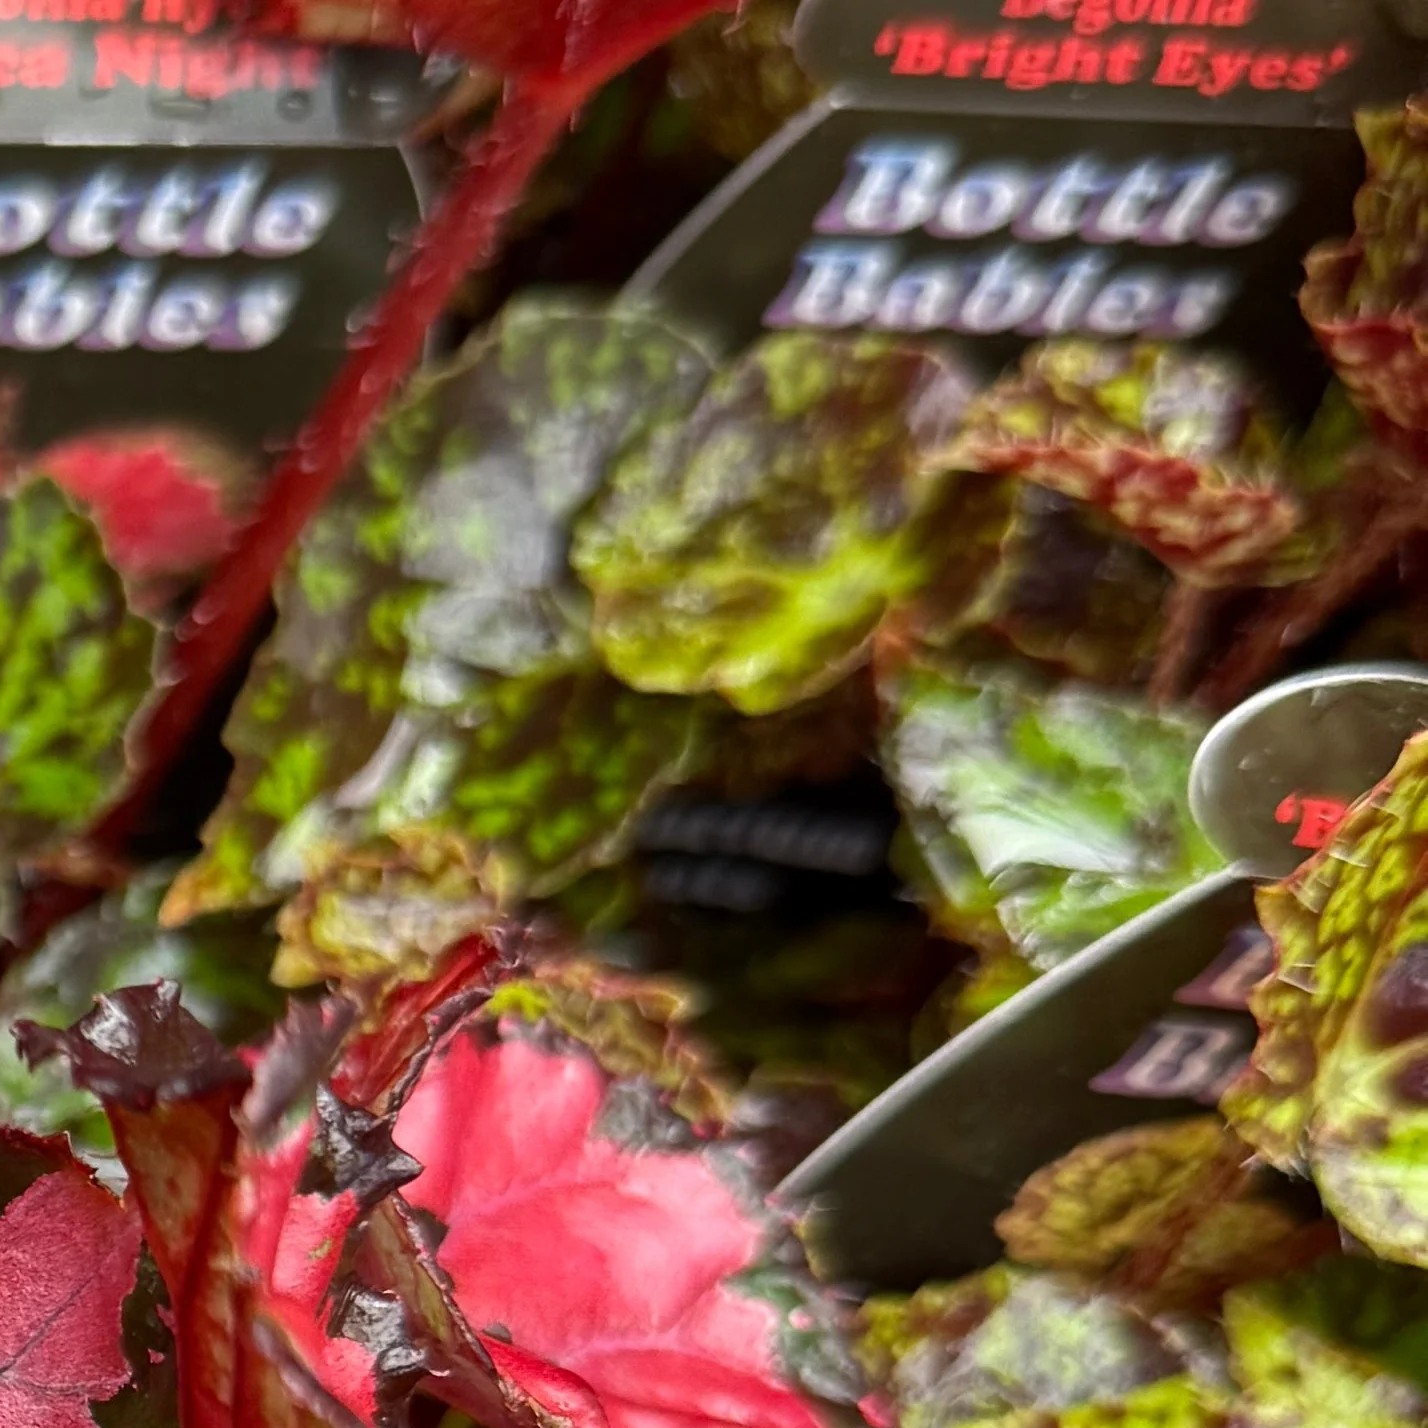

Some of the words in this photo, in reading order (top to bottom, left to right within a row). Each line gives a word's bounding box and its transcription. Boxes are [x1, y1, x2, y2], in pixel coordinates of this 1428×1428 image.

[94, 30, 321, 98] Night
[815, 134, 1294, 247] Bottle
[762, 238, 1235, 340] Babies
